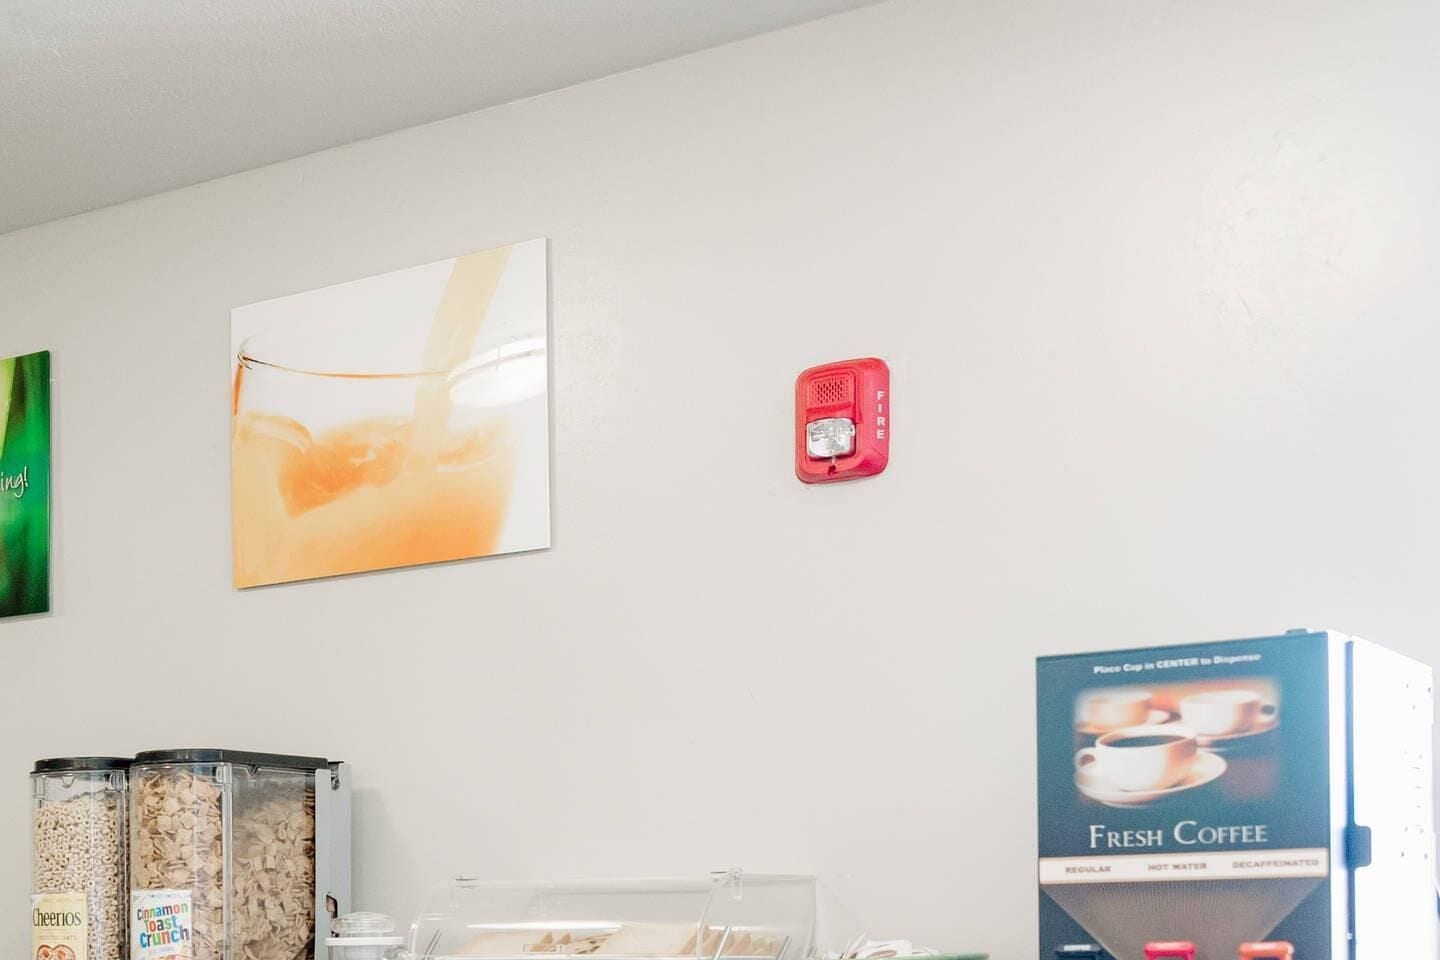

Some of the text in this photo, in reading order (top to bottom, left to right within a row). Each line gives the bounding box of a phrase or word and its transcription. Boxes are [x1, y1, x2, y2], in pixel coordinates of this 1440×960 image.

[876, 390, 886, 440] FIRE
[1093, 653, 1262, 674] Place Cup in CENTER to Dispense
[1064, 865, 1111, 874] REGULAR
[1147, 862, 1207, 871] HOT WATER
[1231, 858, 1319, 869] DECAFFEINATED
[32, 907, 82, 927] Cheerios
